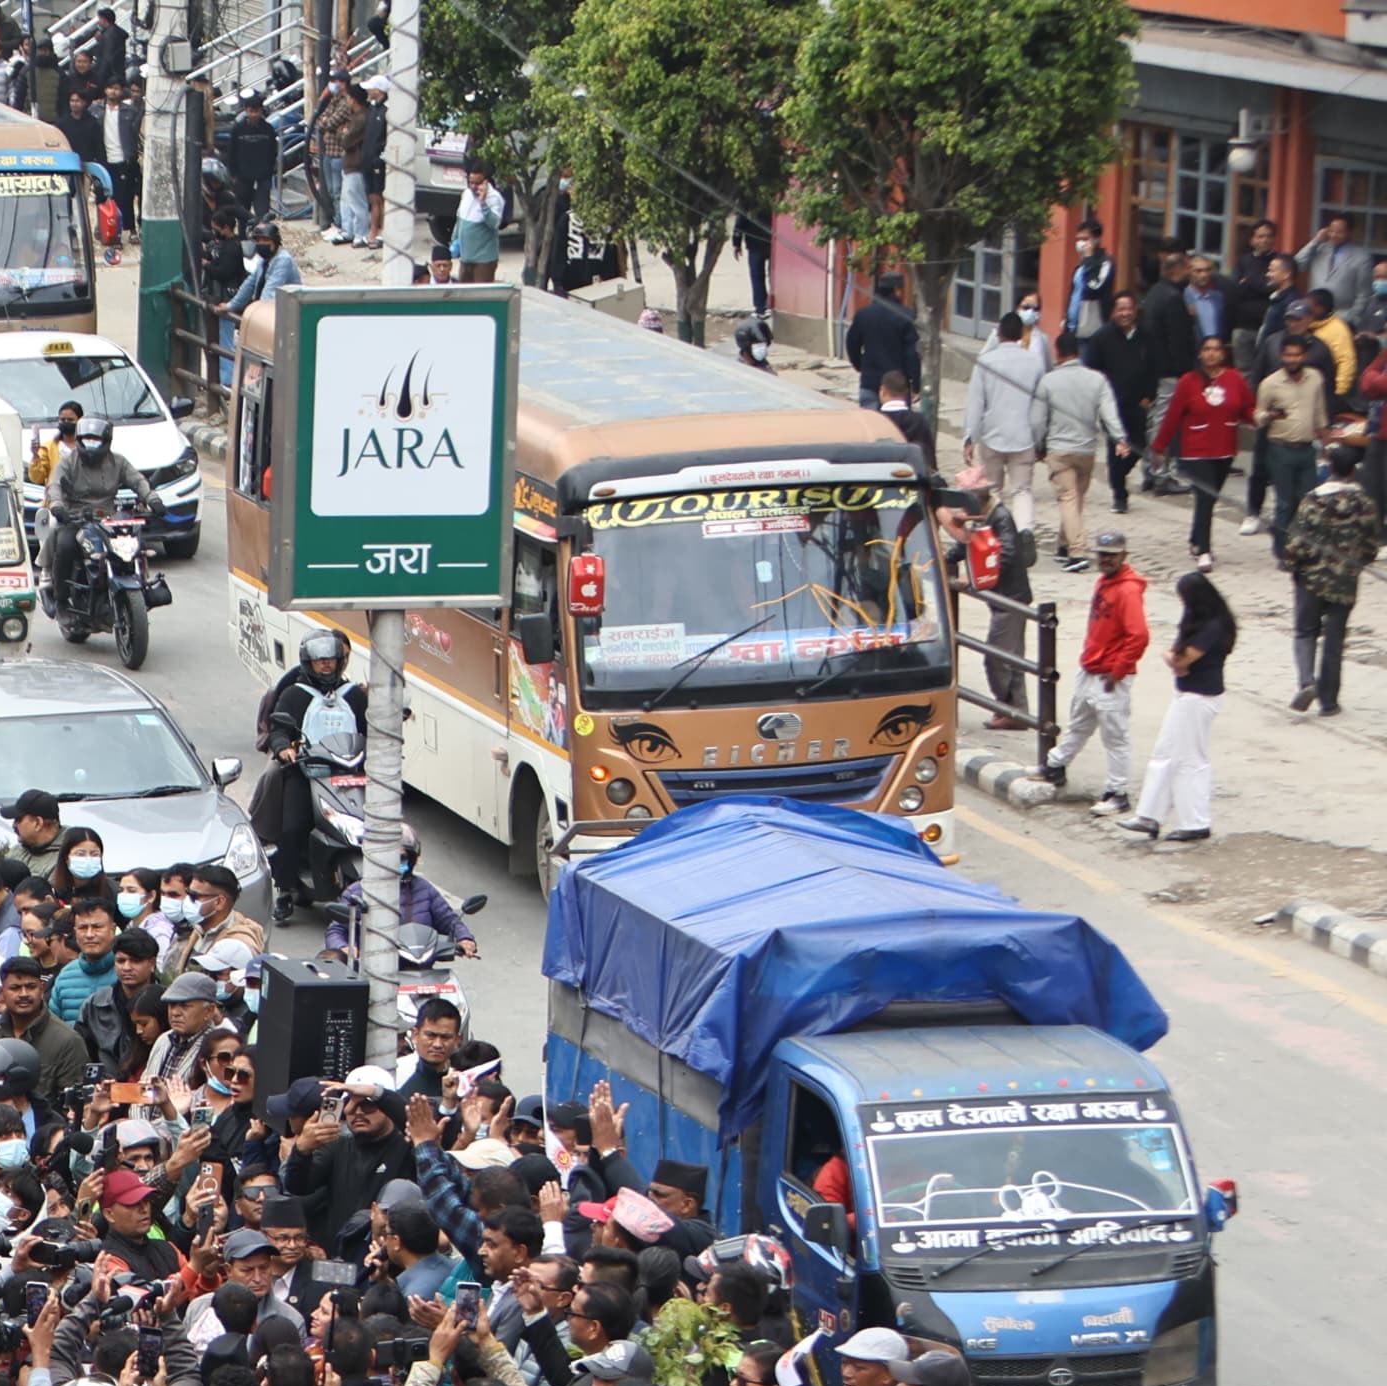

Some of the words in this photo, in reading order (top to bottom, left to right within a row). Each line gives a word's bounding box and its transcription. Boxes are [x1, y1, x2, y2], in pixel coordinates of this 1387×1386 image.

[337, 428, 465, 477] JARA
[362, 543, 432, 574] जरा
[702, 738, 850, 767] EICHER
[894, 1109, 943, 1131] कुल
[947, 1101, 1027, 1126] देउताले
[1031, 1102, 1078, 1123] रक्षा
[915, 1229, 980, 1250] आमा
[1124, 1330, 1151, 1344] XL
